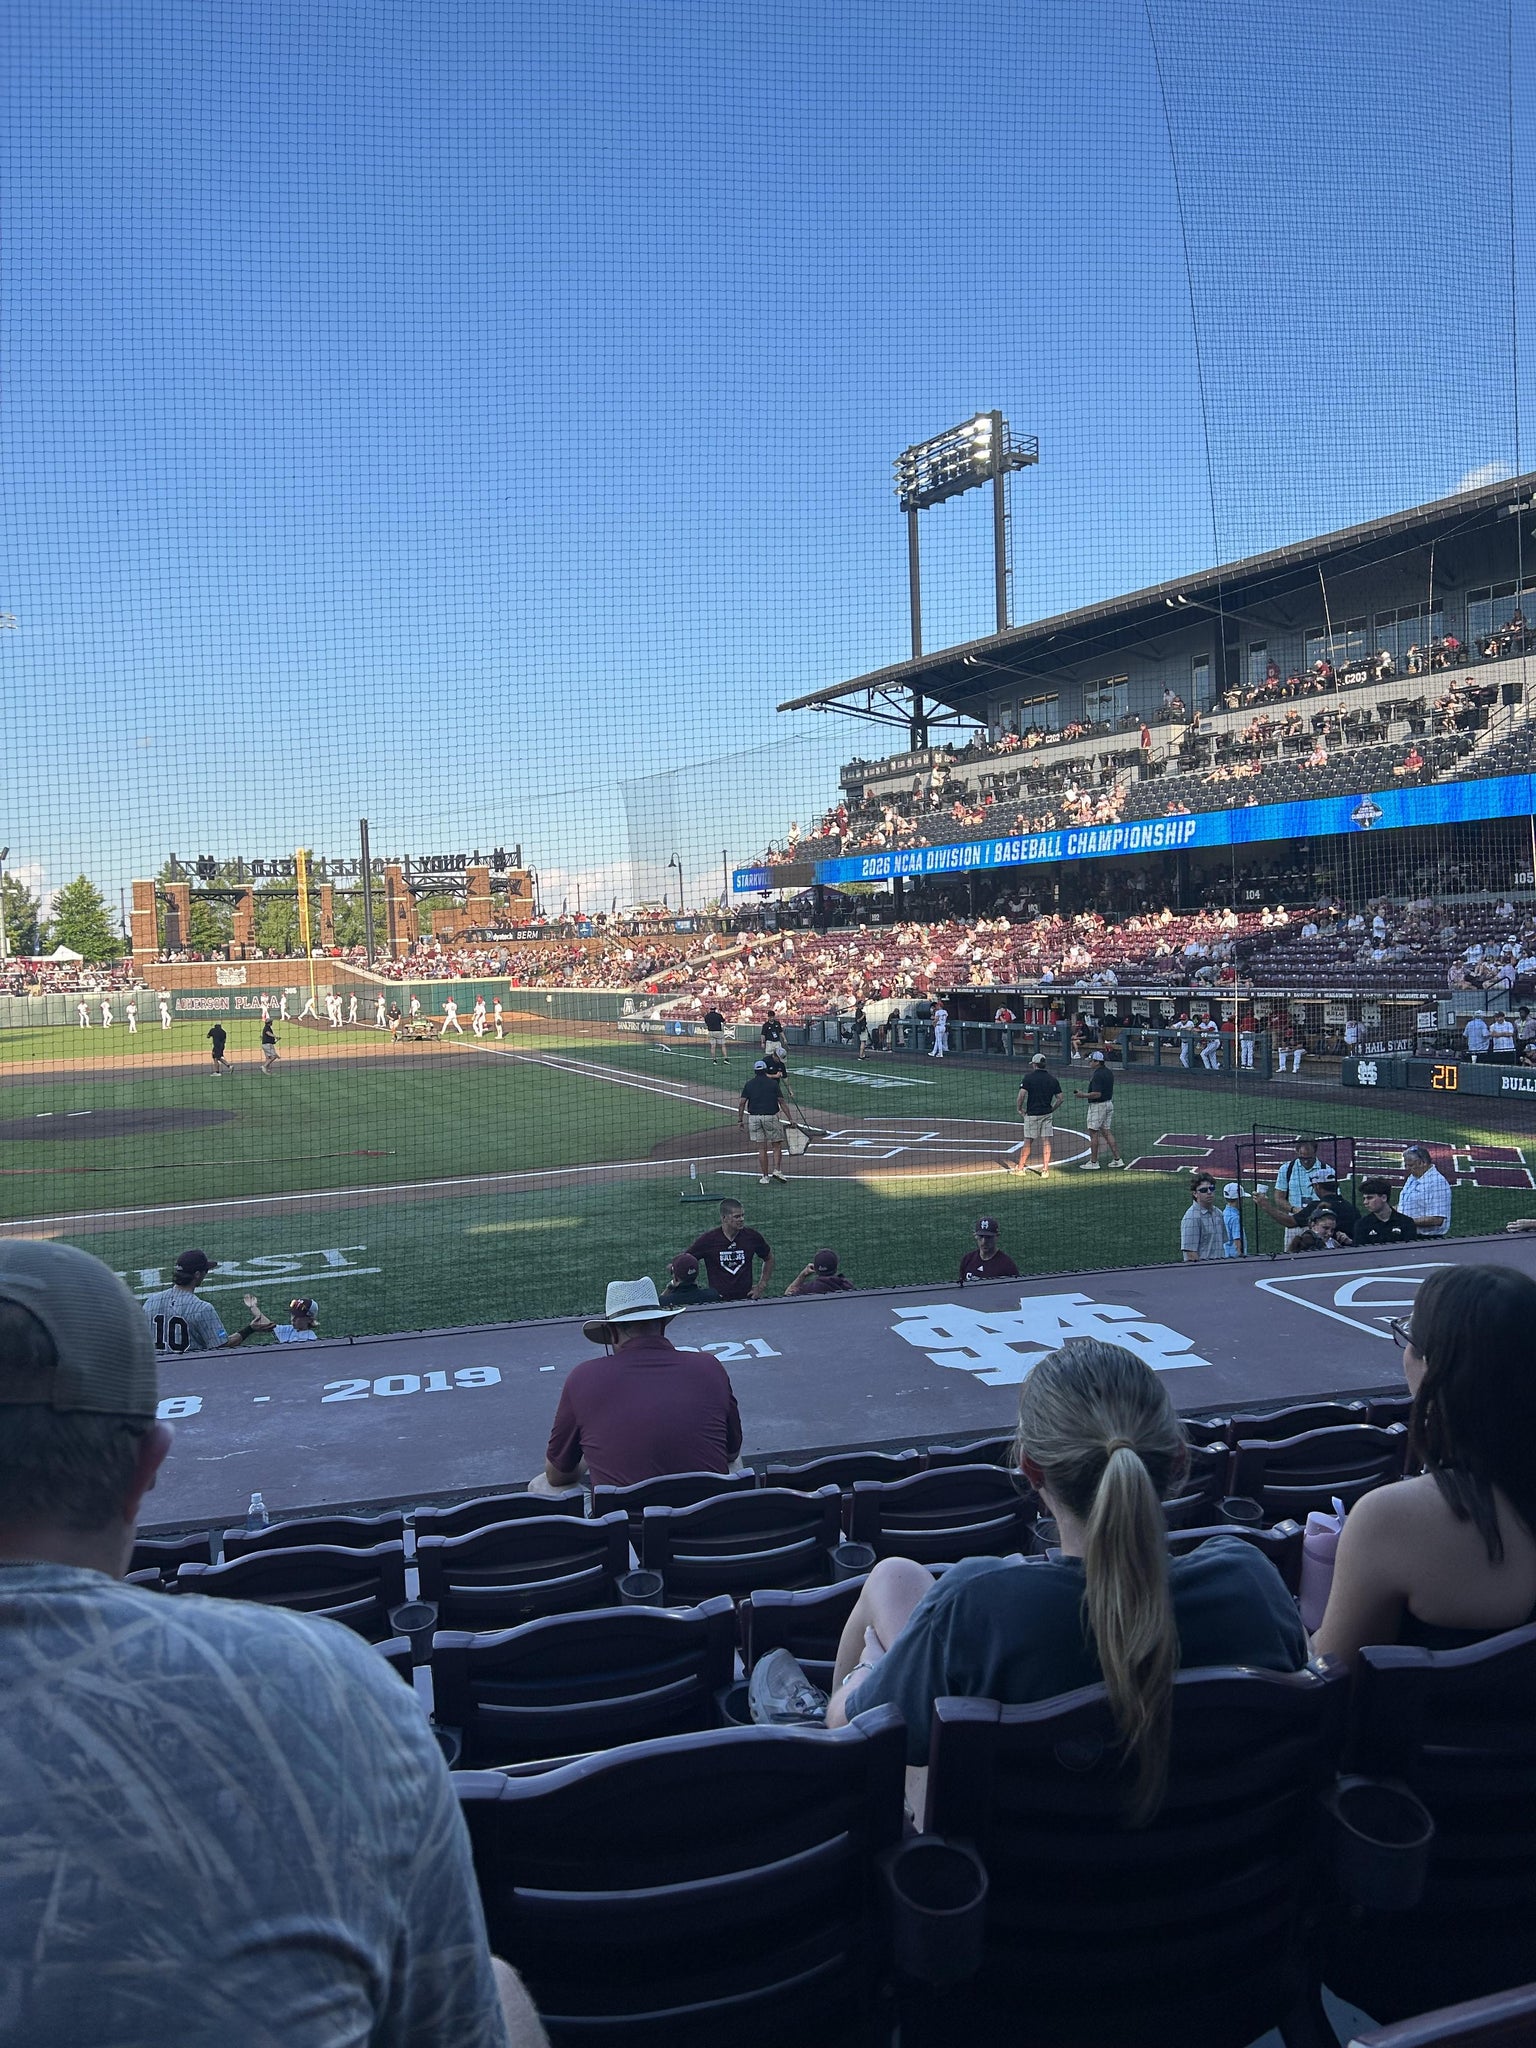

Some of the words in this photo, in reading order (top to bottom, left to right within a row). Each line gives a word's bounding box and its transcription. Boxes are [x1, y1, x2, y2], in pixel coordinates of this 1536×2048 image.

[1344, 671, 1367, 685] C203
[862, 857, 891, 877] 2026
[893, 852, 923, 873] NCAA
[926, 845, 982, 869] DIVISION
[993, 835, 1063, 863] BASEBALL
[1067, 819, 1197, 856] CHAMPIONSHIP
[1514, 872, 1534, 885] 105
[1245, 889, 1261, 900] 104
[516, 930, 539, 940] BERM
[234, 995, 281, 1010] PLAA
[1387, 1039, 1413, 1051] STATE
[152, 1313, 191, 1353] 10
[321, 1366, 502, 1404] 2019
